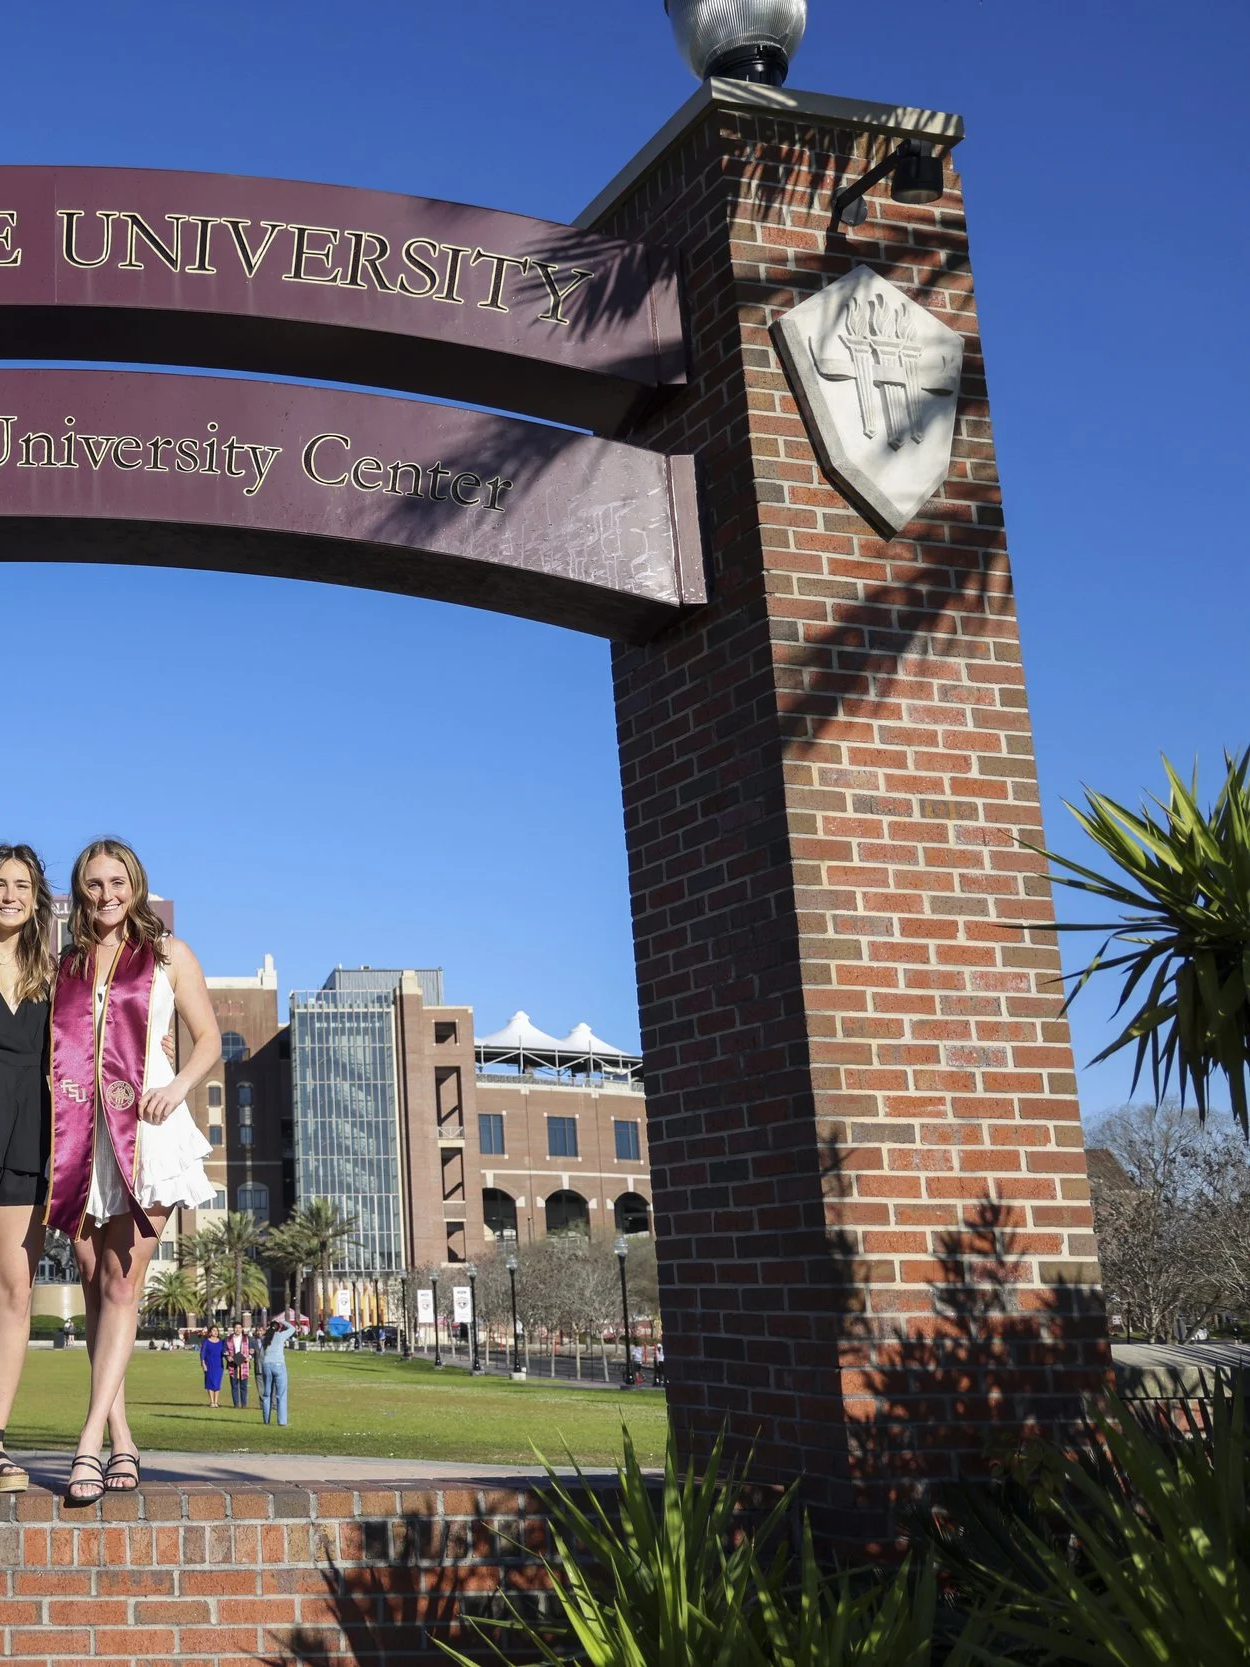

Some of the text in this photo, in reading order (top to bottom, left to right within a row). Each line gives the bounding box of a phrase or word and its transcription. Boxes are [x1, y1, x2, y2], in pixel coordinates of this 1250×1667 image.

[56, 209, 594, 327] UNIVERSITY
[301, 433, 514, 513] Center
[60, 1079, 88, 1103] FSU
